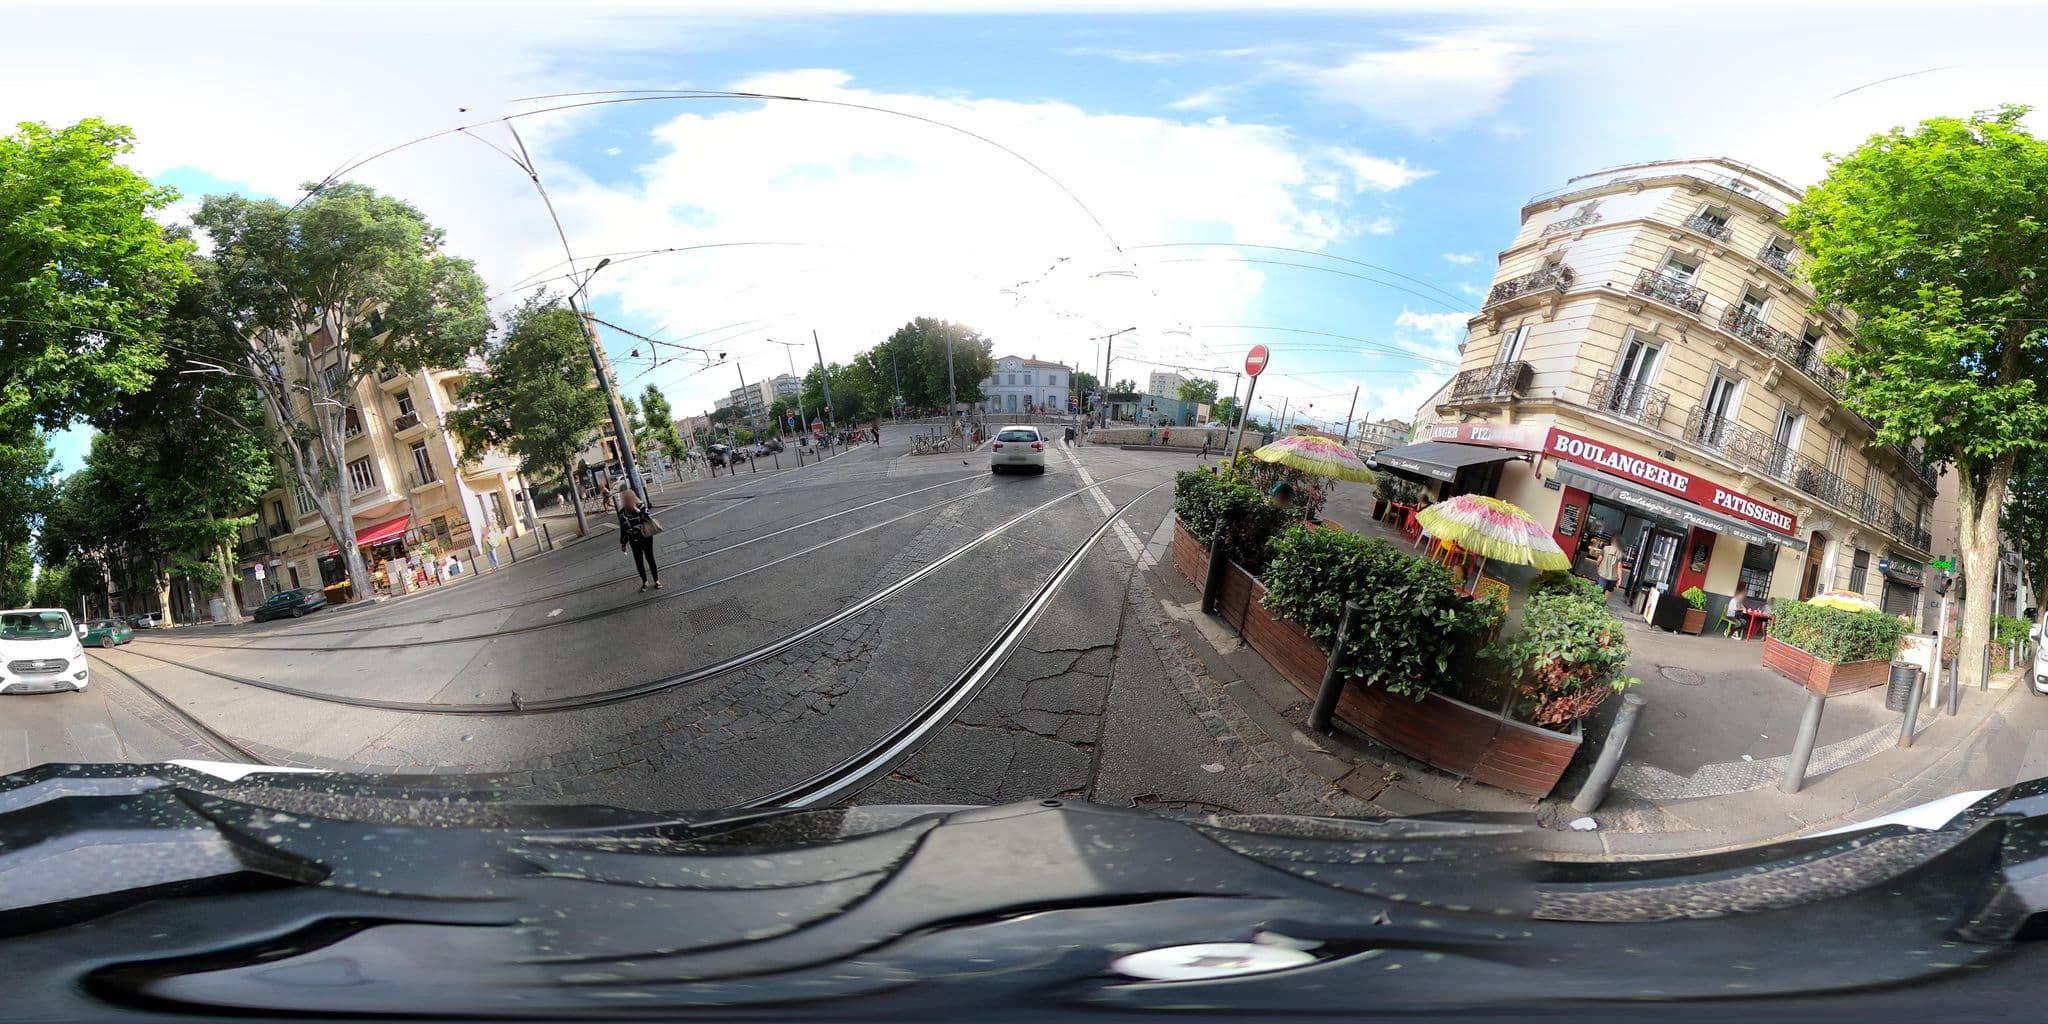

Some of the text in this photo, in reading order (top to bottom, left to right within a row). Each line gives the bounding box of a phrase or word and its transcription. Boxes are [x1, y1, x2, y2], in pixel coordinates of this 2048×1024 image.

[1554, 434, 1793, 531] BOULANGERIE PATISSERIE
[1619, 491, 1672, 515] Boulangerie
[1683, 512, 1723, 531] Patisserie
